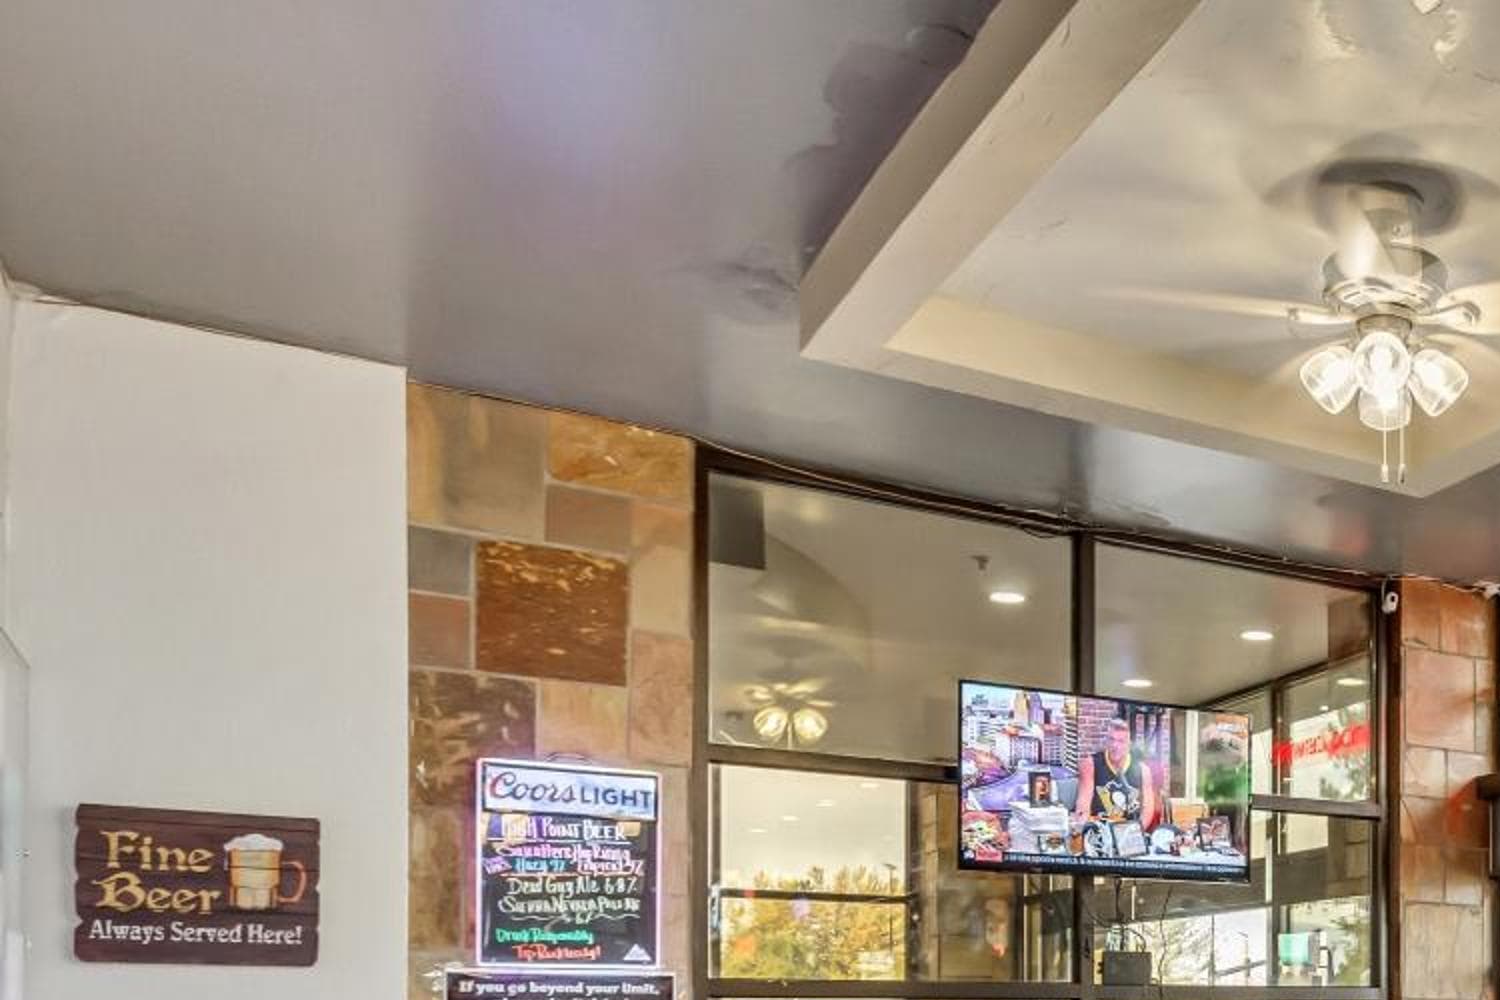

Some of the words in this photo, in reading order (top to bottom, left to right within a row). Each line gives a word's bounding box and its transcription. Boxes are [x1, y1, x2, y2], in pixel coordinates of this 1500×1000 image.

[490, 771, 577, 801] Coors
[580, 787, 652, 809] LIGHT
[99, 830, 214, 873] Fine
[91, 871, 222, 914] Beer
[89, 919, 165, 945] Always
[170, 921, 242, 945] Served
[247, 923, 302, 945] Here!
[458, 980, 475, 994] If
[475, 984, 505, 996] you
[507, 984, 526, 996] go
[529, 979, 584, 996] beyond
[586, 982, 620, 996] your
